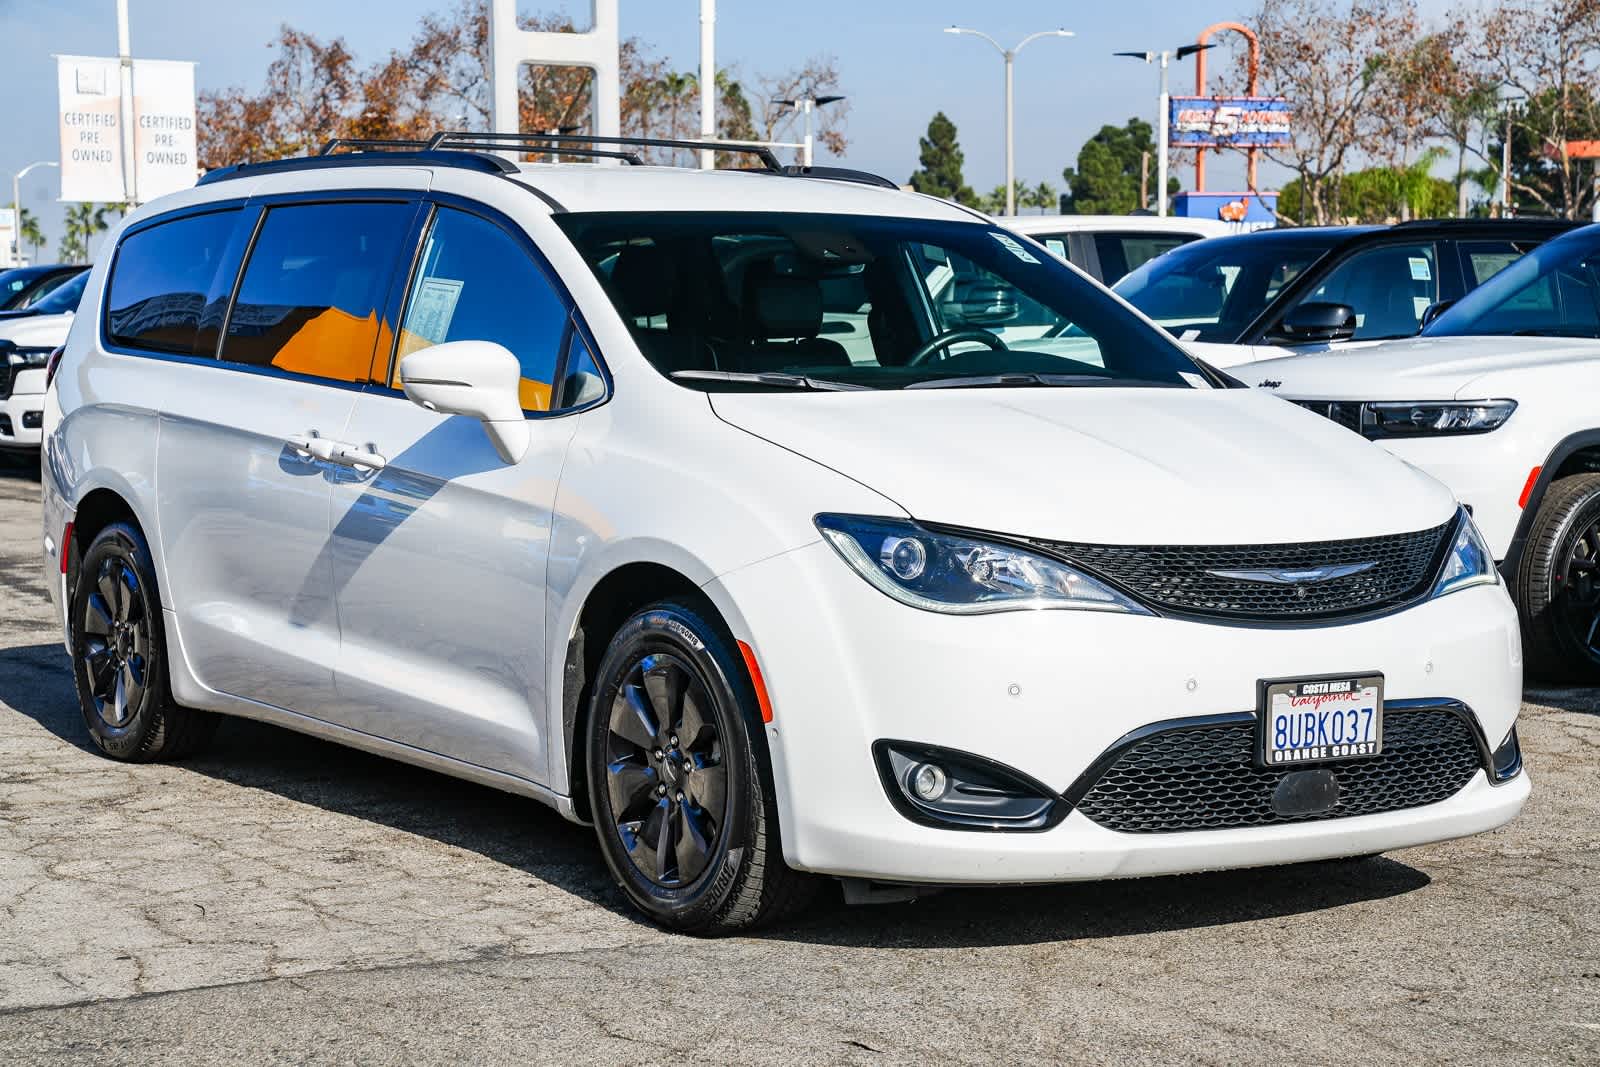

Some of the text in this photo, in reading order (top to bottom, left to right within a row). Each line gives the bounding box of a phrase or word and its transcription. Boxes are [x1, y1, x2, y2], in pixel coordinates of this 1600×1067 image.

[64, 112, 116, 127] CERTIFIED
[139, 115, 192, 130] CERTIFIED
[72, 149, 112, 162] OWNED
[147, 151, 188, 165] OWNED
[1302, 681, 1351, 695] COSTA MESA
[1275, 708, 1373, 749] 8UBK037
[1275, 742, 1375, 761] ORANGE COAST
